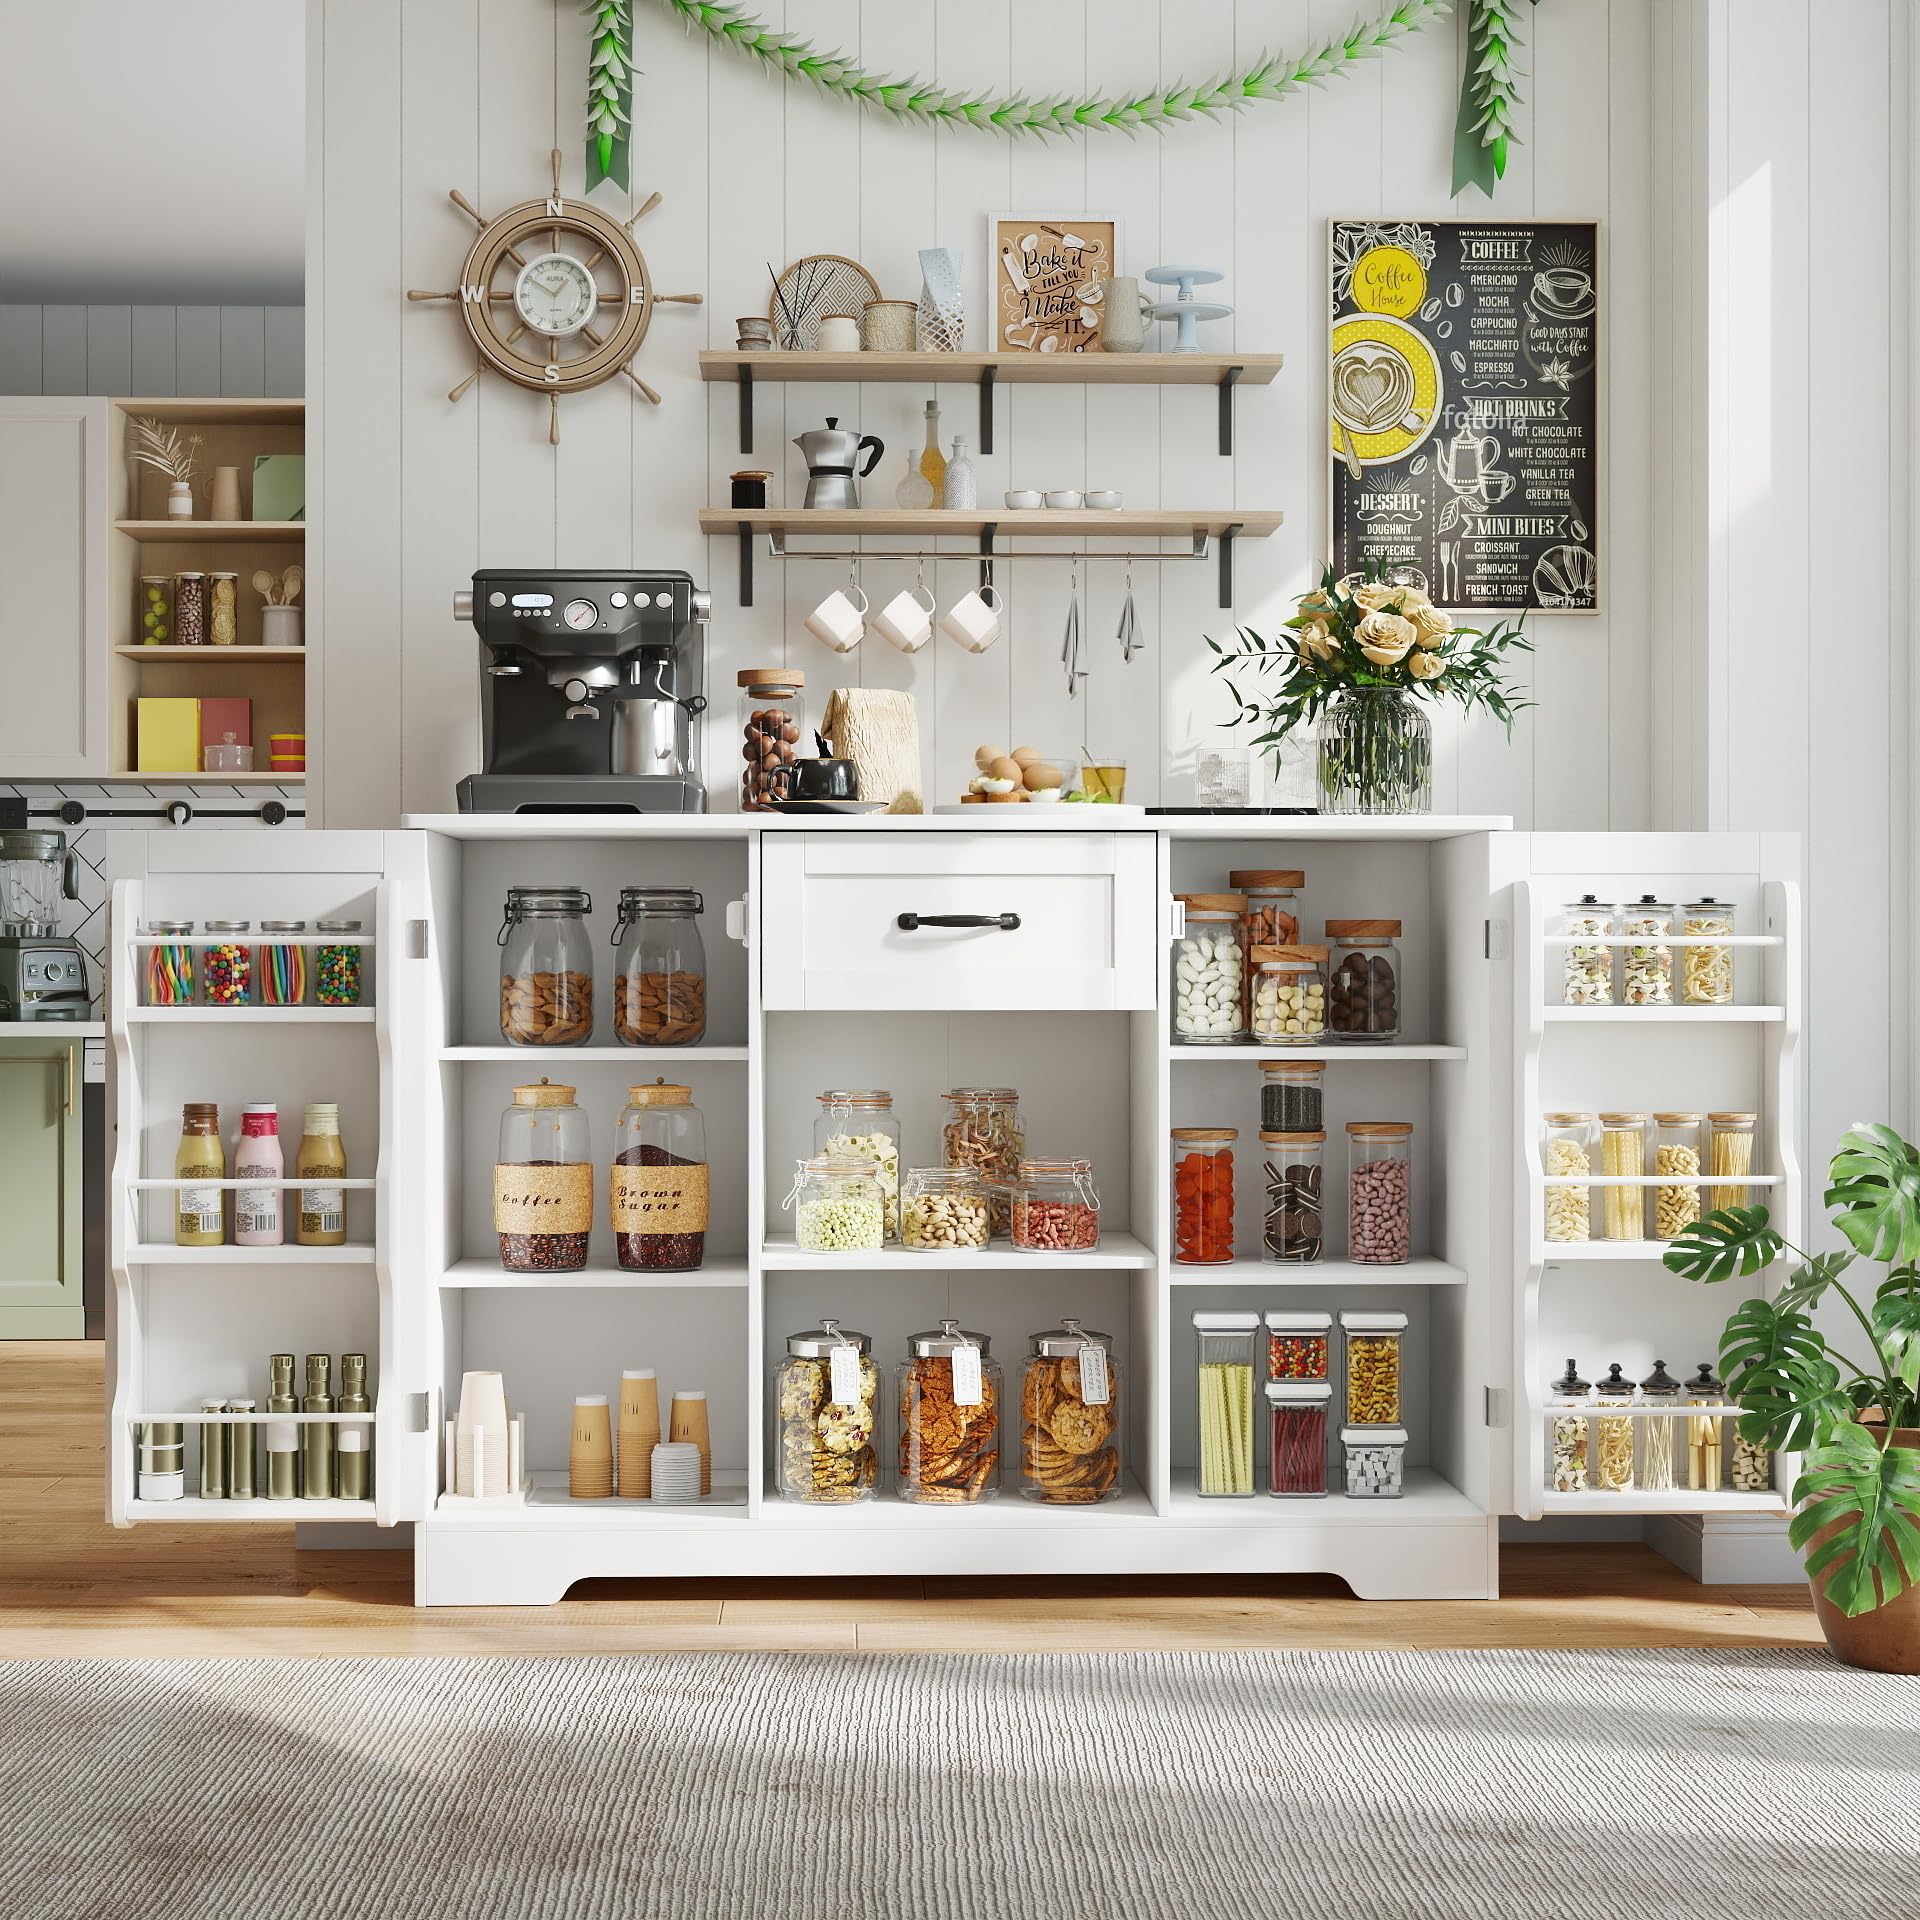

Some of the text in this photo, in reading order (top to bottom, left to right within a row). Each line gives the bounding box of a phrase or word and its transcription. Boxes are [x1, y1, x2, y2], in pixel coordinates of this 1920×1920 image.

[546, 198, 563, 216] N
[1471, 241, 1519, 259] COFFEE
[1022, 245, 1099, 279] Bake it
[1042, 269, 1079, 289] TILL YOU
[1364, 262, 1415, 289] Coffee
[1470, 274, 1518, 286] AMERICANO
[460, 285, 485, 303] W
[630, 286, 644, 304] E
[1370, 286, 1407, 308] House
[1020, 285, 1079, 319] Make
[1479, 296, 1510, 307] MOCHA
[1470, 317, 1518, 329] CAPPUCINO
[1530, 326, 1589, 339] GOOD DAYS START
[1469, 339, 1519, 351] MACCHIATO
[1531, 338, 1589, 356] with Coffee
[544, 364, 560, 383] S
[1474, 362, 1514, 373] ESPRESSO
[1474, 399, 1556, 417] HOT DRINKS
[1511, 426, 1583, 438] HOT CHOCOLATE
[1508, 447, 1587, 459] WHITE CHOCOLATE
[1521, 469, 1575, 480] VANILLA TEA
[1525, 489, 1570, 500] GREEN TEA
[1360, 493, 1420, 511] DESSERT
[1367, 523, 1412, 535] DOUGHNUT
[1477, 517, 1555, 536] MINI BITES
[1364, 545, 1416, 556] CHEESECAKE
[1474, 542, 1520, 553] CROISSANT
[1476, 563, 1518, 574] SANDWICH
[1465, 584, 1529, 595] FRENCH TOAST
[617, 1186, 682, 1198] Brown
[502, 1194, 562, 1206] Coffee
[618, 1199, 681, 1212] Sugar
